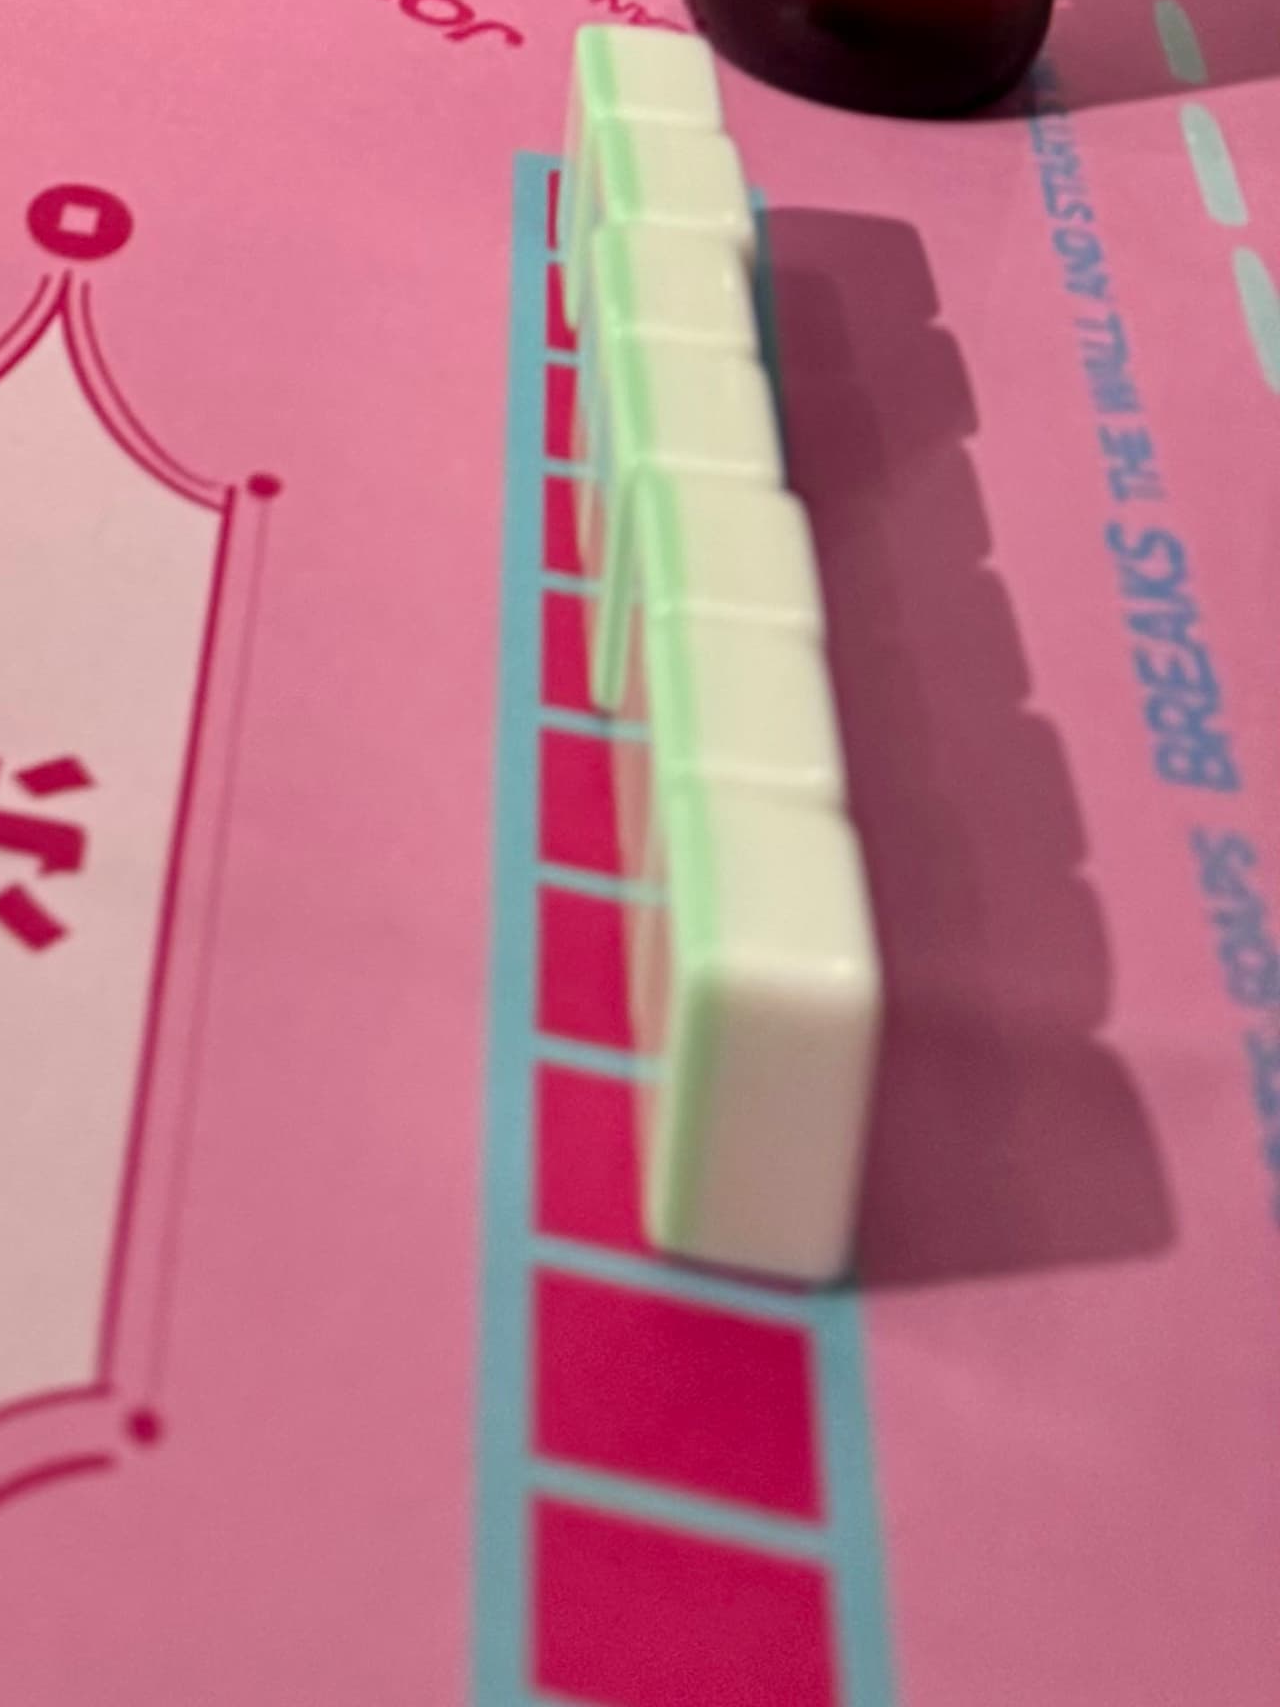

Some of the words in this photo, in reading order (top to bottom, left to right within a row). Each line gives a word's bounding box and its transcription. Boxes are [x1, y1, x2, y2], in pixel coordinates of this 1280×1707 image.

[1050, 224, 1113, 304] AND
[1074, 311, 1145, 417] WALL
[1097, 425, 1167, 503] THE
[1102, 522, 1243, 793] BREAKS
